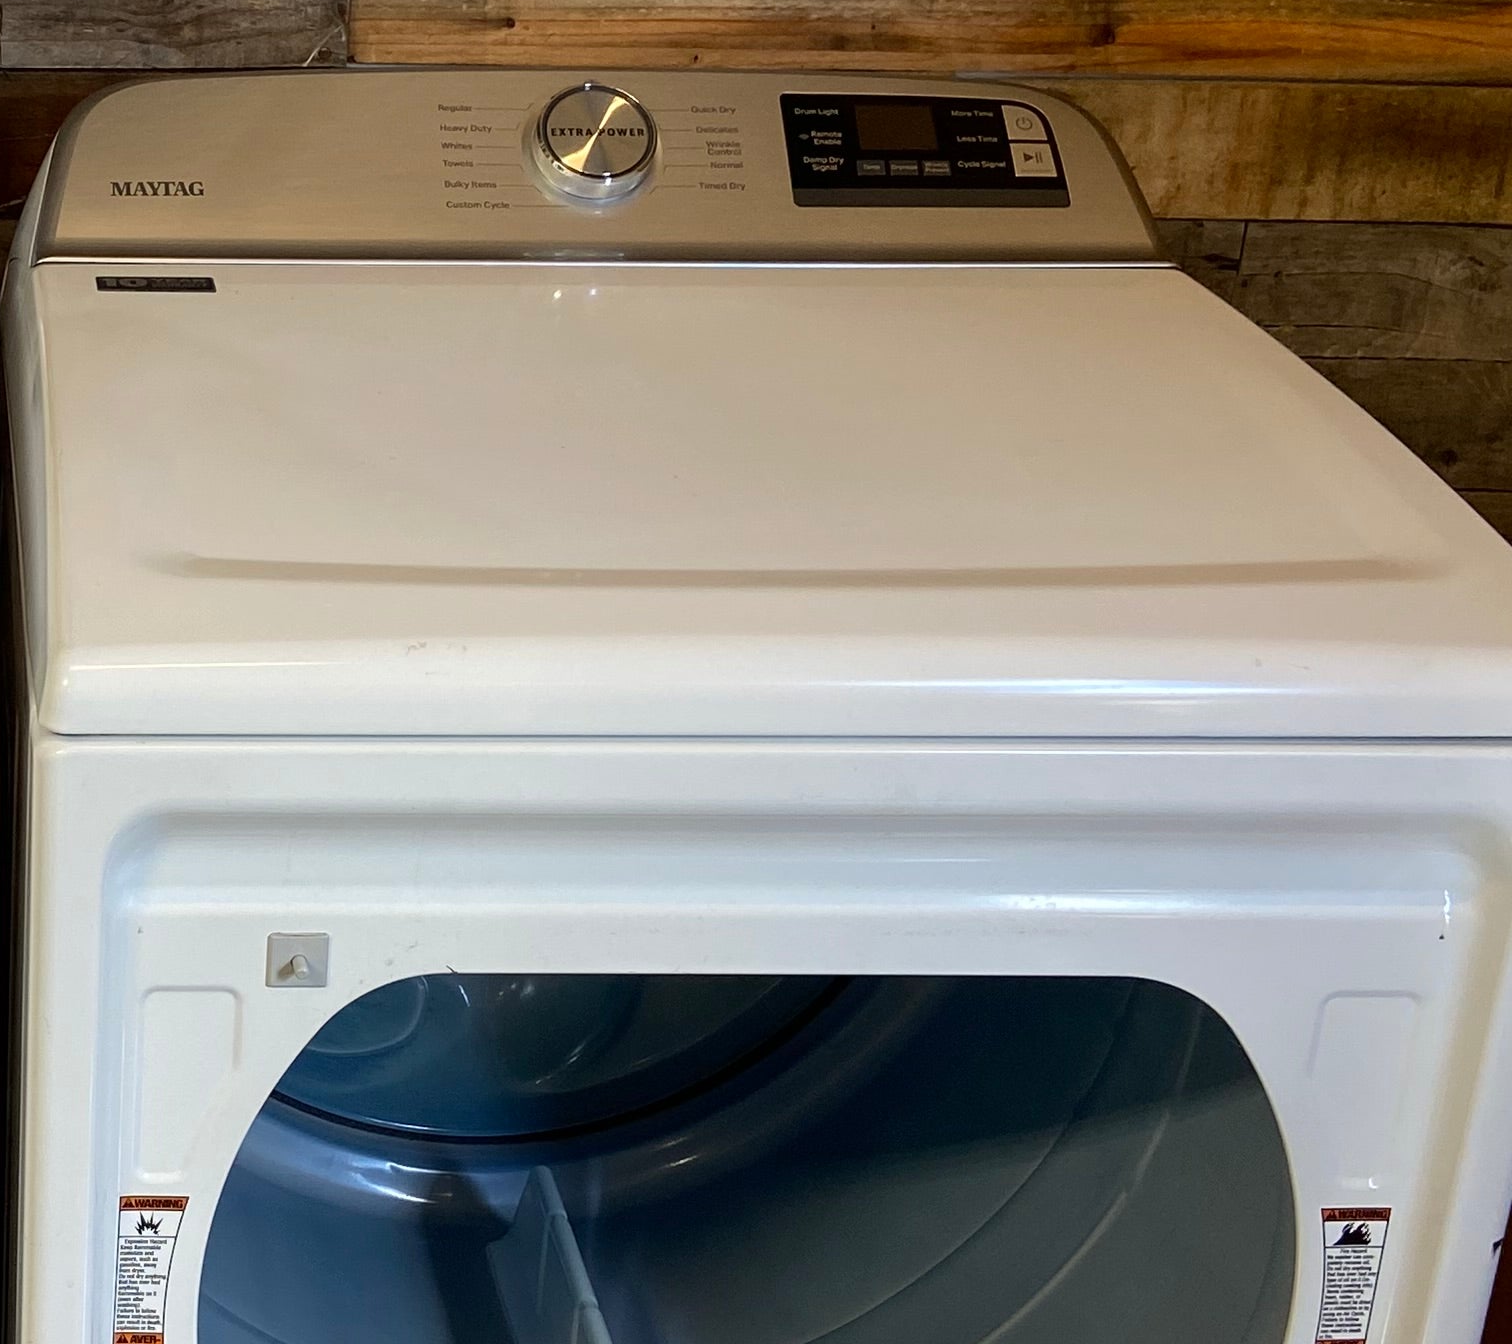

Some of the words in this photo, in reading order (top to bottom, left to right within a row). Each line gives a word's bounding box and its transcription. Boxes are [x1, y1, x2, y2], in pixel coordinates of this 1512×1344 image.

[438, 104, 472, 113] Regular
[690, 106, 715, 114] Quick
[717, 106, 736, 116] Dry
[818, 108, 839, 116] Light
[951, 110, 972, 118] More
[974, 110, 994, 118] Time
[440, 124, 470, 134] Heavy
[472, 124, 492, 135] Duty
[550, 127, 593, 137] EXTRA
[597, 128, 645, 138] POWER
[695, 126, 738, 134] Delicates
[810, 130, 842, 138] Remote
[440, 142, 473, 151] Whites
[705, 140, 741, 148] Wrinkle
[814, 138, 842, 146] Enable
[707, 148, 742, 156] Control
[442, 160, 474, 168] Towels
[803, 156, 828, 164] Damp
[828, 156, 844, 165] Dry
[957, 160, 979, 168] Cycle
[980, 160, 1006, 170] Signal
[709, 161, 744, 170] Normal
[110, 181, 205, 198] MAYTAG
[444, 180, 470, 190] Bulky
[471, 180, 497, 189] Items
[698, 182, 727, 190] Timed
[729, 182, 746, 192] Dry
[446, 200, 481, 210] Custom
[484, 200, 510, 212] Cycle
[134, 1199, 184, 1209] WARNING
[130, 1334, 161, 1344] AVER-
